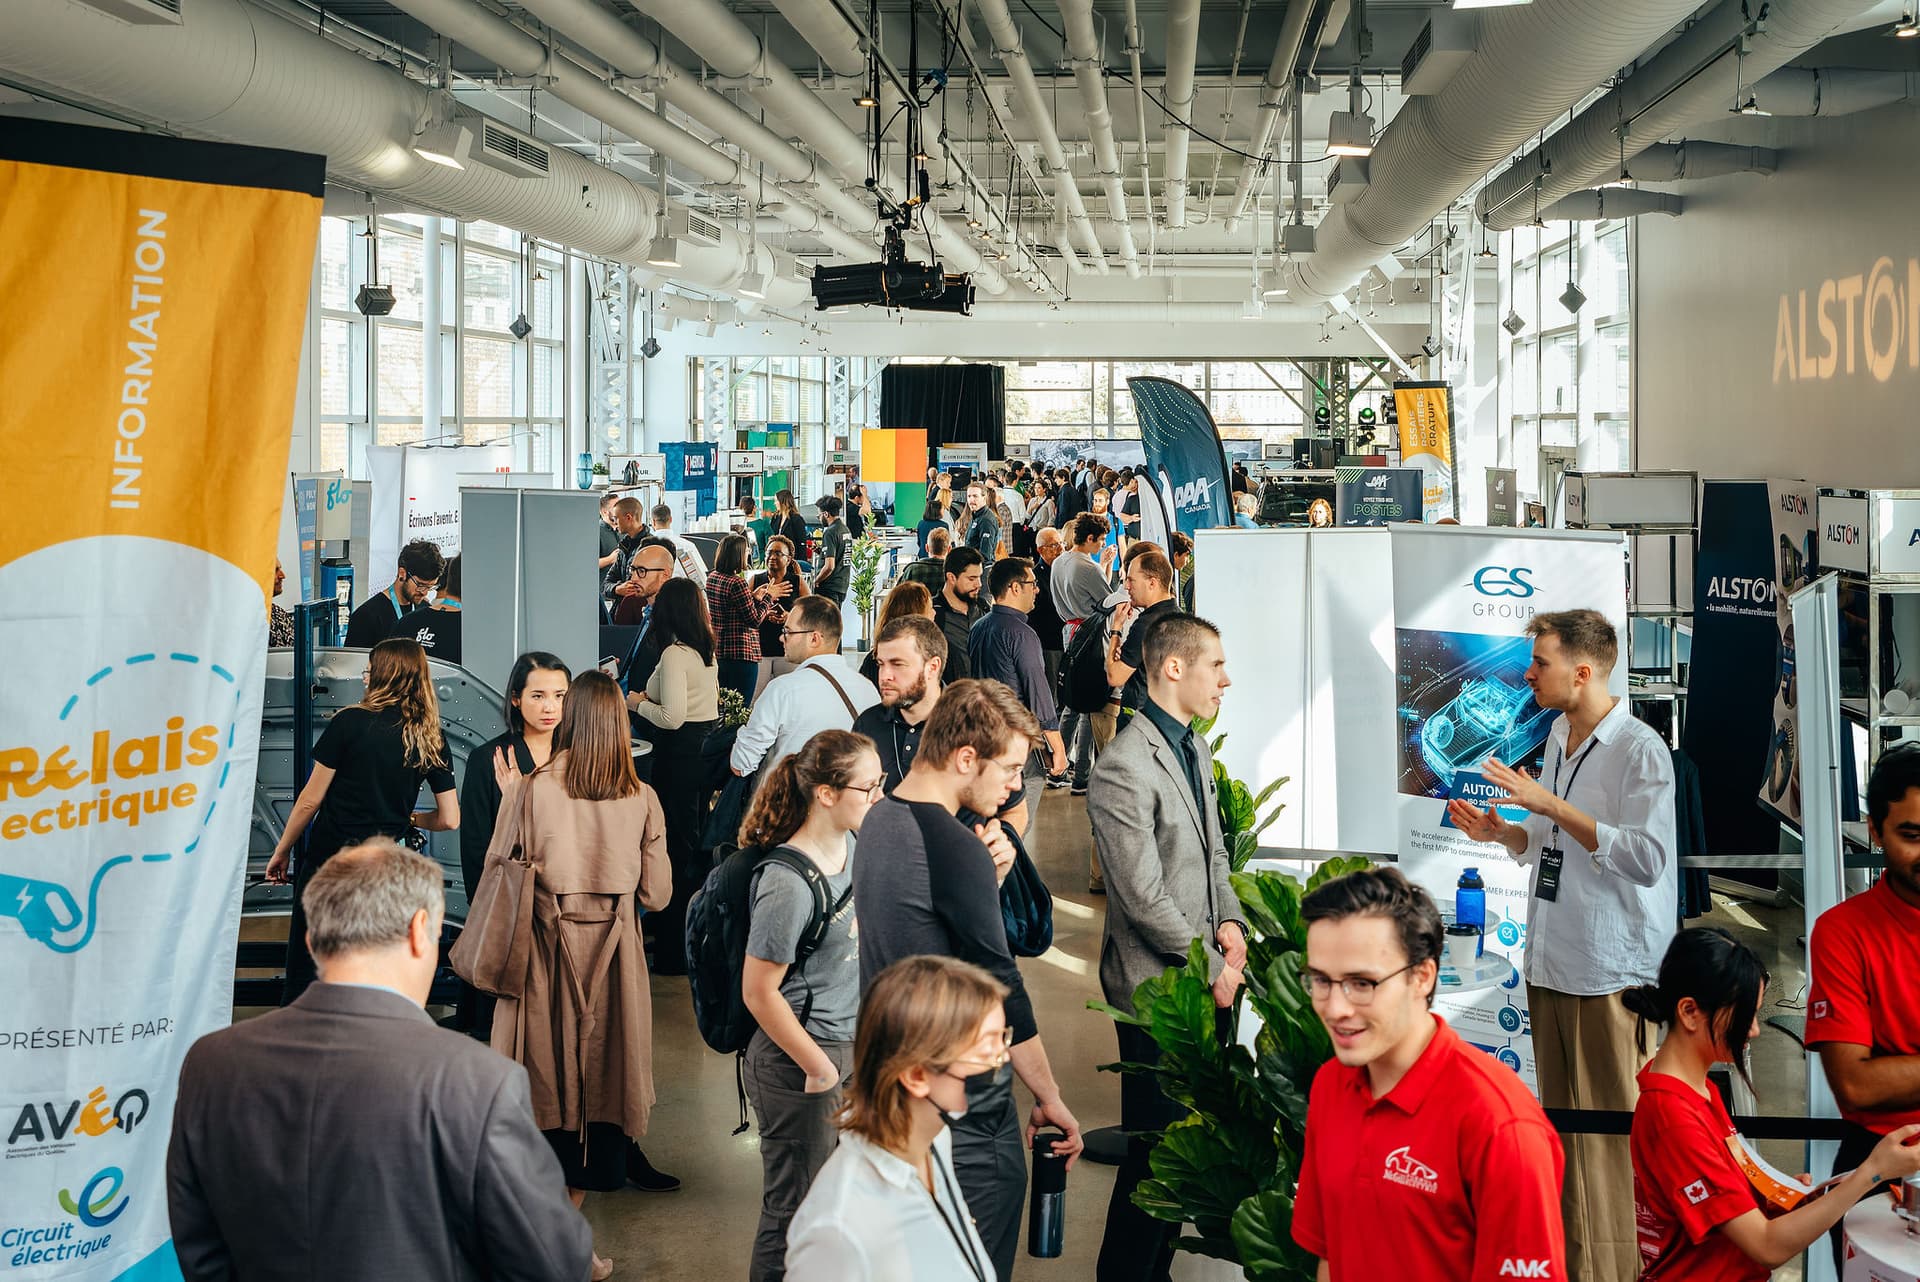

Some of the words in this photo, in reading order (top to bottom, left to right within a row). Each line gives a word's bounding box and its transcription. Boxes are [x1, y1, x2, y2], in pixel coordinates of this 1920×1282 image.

[110, 208, 168, 509] INFORMATION
[327, 479, 353, 511] flo
[1780, 493, 1809, 516] ALSTOM
[409, 509, 432, 527] Écrivons
[1184, 503, 1212, 514] CANADA
[1353, 503, 1403, 516] POSTES
[1827, 523, 1860, 545] ALSTOM
[1473, 602, 1535, 619] GROUP
[416, 627, 435, 641] flo
[1411, 829, 1421, 838] We
[1421, 831, 1457, 844] accelerates
[1411, 841, 1421, 849] the
[1422, 843, 1435, 851] first
[1435, 844, 1450, 853] MVP
[0, 1022, 124, 1050] PRÉSENTÉ
[131, 1018, 174, 1041] PAR:
[8, 1086, 149, 1145] AVÉQ
[1, 1222, 75, 1248] Circuit
[11, 1233, 112, 1267] électrique
[1499, 1258, 1551, 1279] AMK
